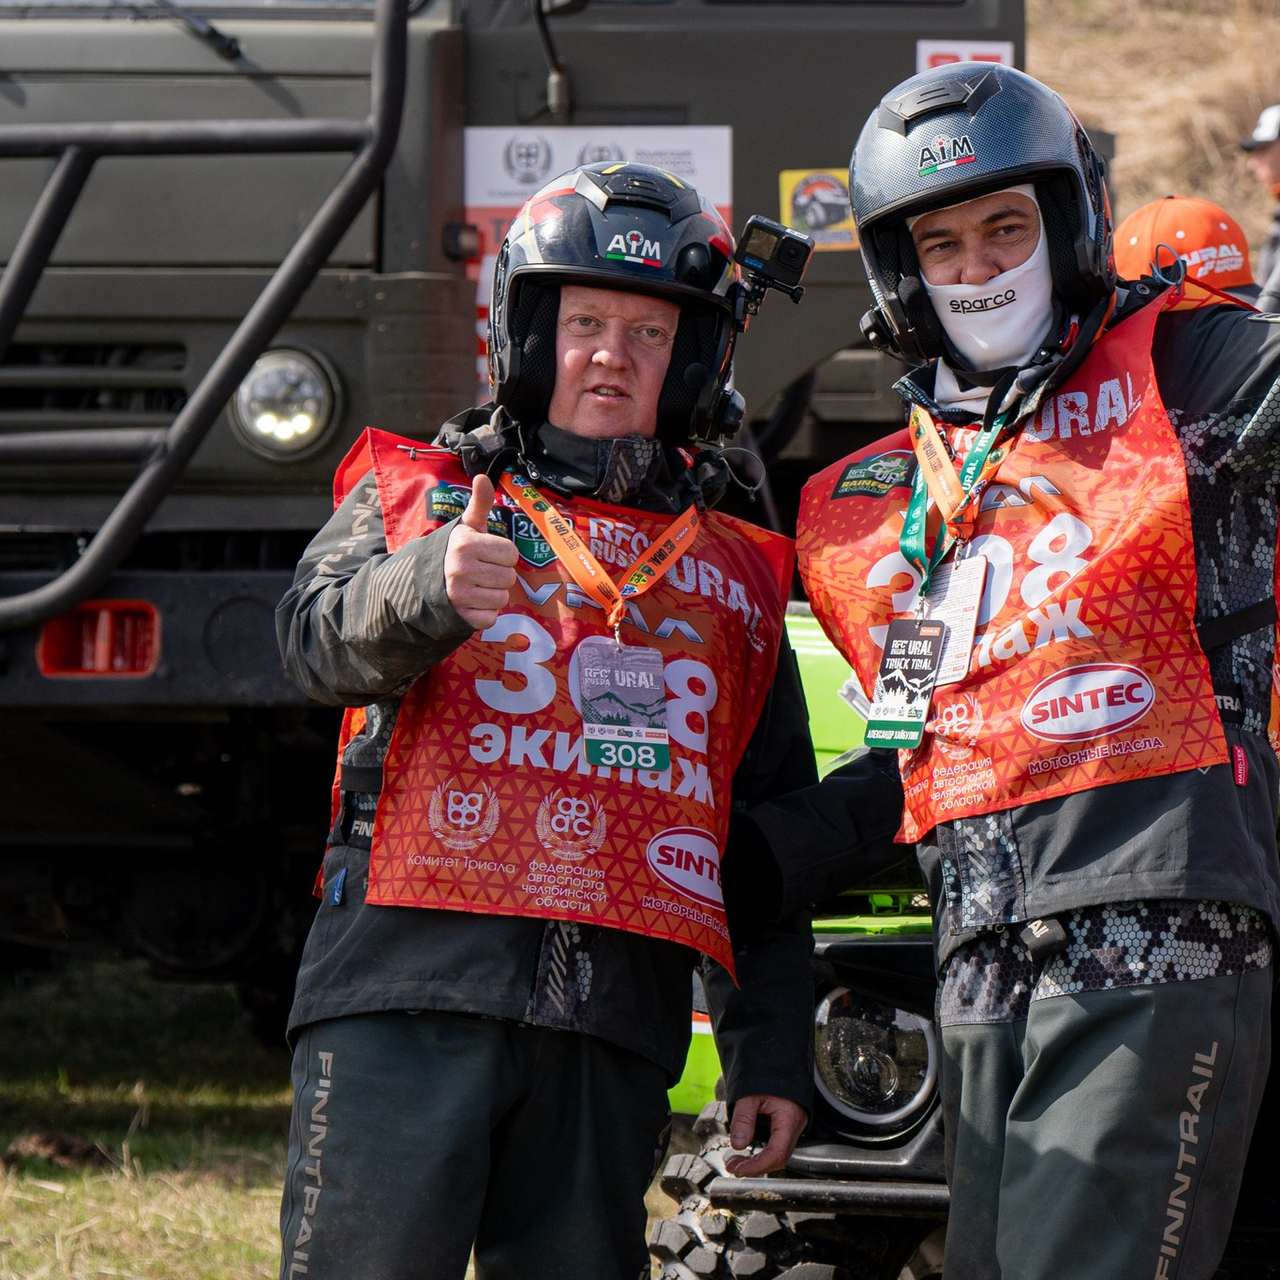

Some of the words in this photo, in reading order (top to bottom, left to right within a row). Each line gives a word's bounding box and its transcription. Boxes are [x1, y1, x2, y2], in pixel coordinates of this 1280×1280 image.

[1180, 244, 1242, 267] URAL
[950, 289, 1016, 314] sparco
[1023, 371, 1142, 443] URAL
[921, 436, 937, 461] URAL
[962, 460, 979, 491] URAL
[548, 514, 569, 537] URAL
[647, 548, 669, 567] URAL
[907, 640, 933, 655] URAL
[886, 658, 910, 669] TRUCK
[911, 658, 932, 670] TRIAL
[614, 669, 660, 690] URAL
[1031, 682, 1145, 725] SINTEC
[600, 742, 656, 768] 308
[1028, 746, 1109, 774] МОТОРНЫЕ
[1111, 737, 1164, 756] МАСЛА
[932, 757, 993, 779] федерация
[932, 768, 994, 790] автоспорта
[930, 777, 996, 801] челябинской
[939, 793, 985, 811] области
[407, 853, 461, 868] Комитет
[464, 856, 516, 874] Триала
[528, 859, 605, 879] федерация
[656, 844, 722, 888] SINT
[527, 872, 605, 891] автоспорта
[522, 884, 607, 903] челябинской
[535, 895, 590, 912] области
[642, 896, 712, 927] МОТОРНЫЕ
